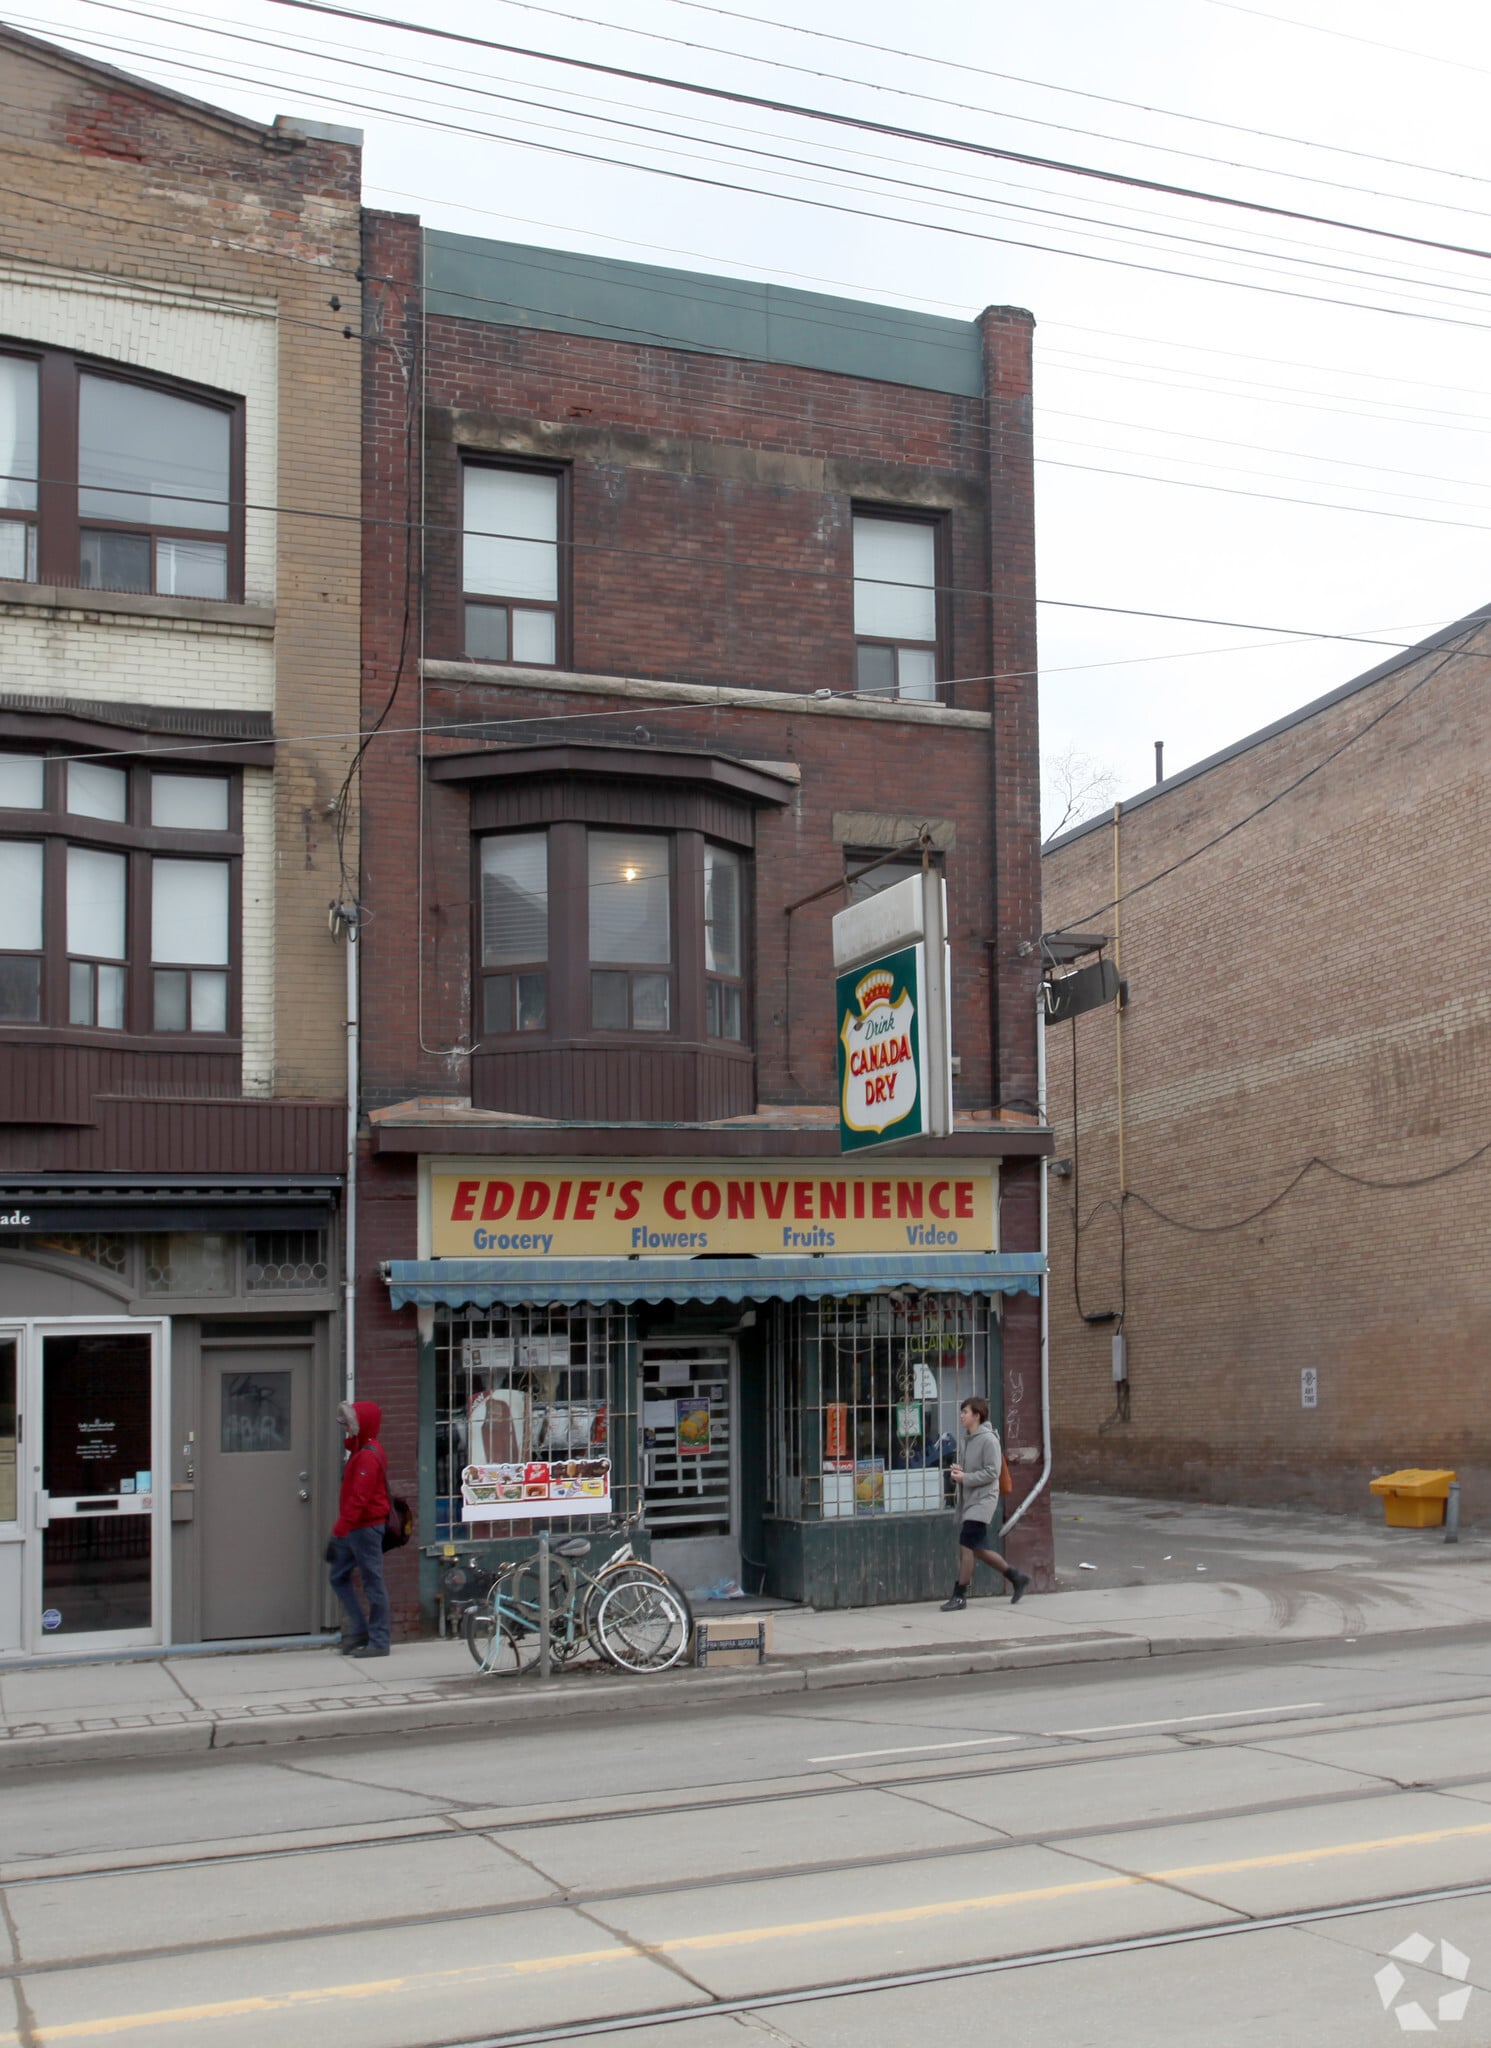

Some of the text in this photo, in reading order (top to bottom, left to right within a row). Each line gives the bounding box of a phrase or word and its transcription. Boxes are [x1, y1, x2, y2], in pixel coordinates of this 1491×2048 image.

[865, 1012, 895, 1040] Drink
[850, 1035, 911, 1077] CANADA
[865, 1072, 898, 1106] DRY
[450, 1180, 974, 1221] EDDIE'S CONVENIENCE
[0, 1209, 31, 1225] ade
[473, 1224, 959, 1253] Grocery Flowers Fruits Video
